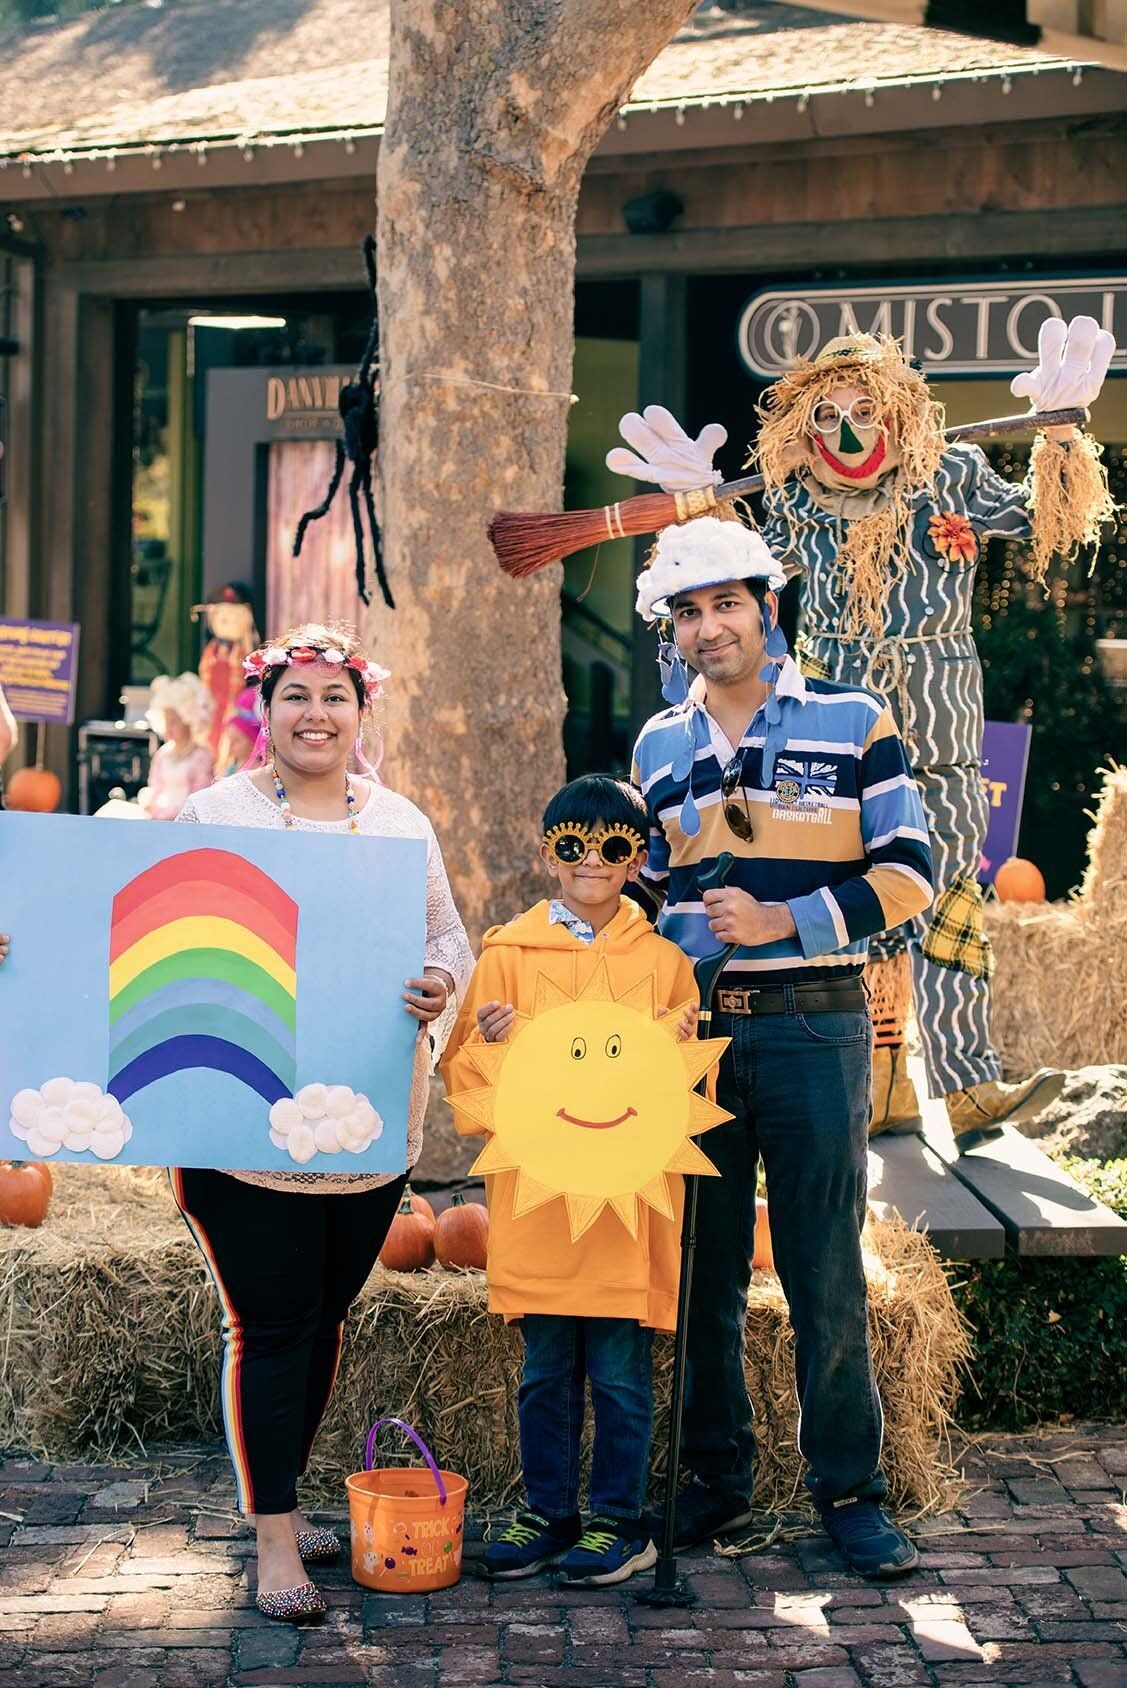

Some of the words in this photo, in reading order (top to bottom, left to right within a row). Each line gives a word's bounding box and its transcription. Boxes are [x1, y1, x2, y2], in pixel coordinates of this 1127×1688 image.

[838, 293, 1066, 363] MISTO
[772, 807, 832, 824] BASKETBALL
[412, 1517, 450, 1538] TRICK
[408, 1555, 448, 1577] TREAT
